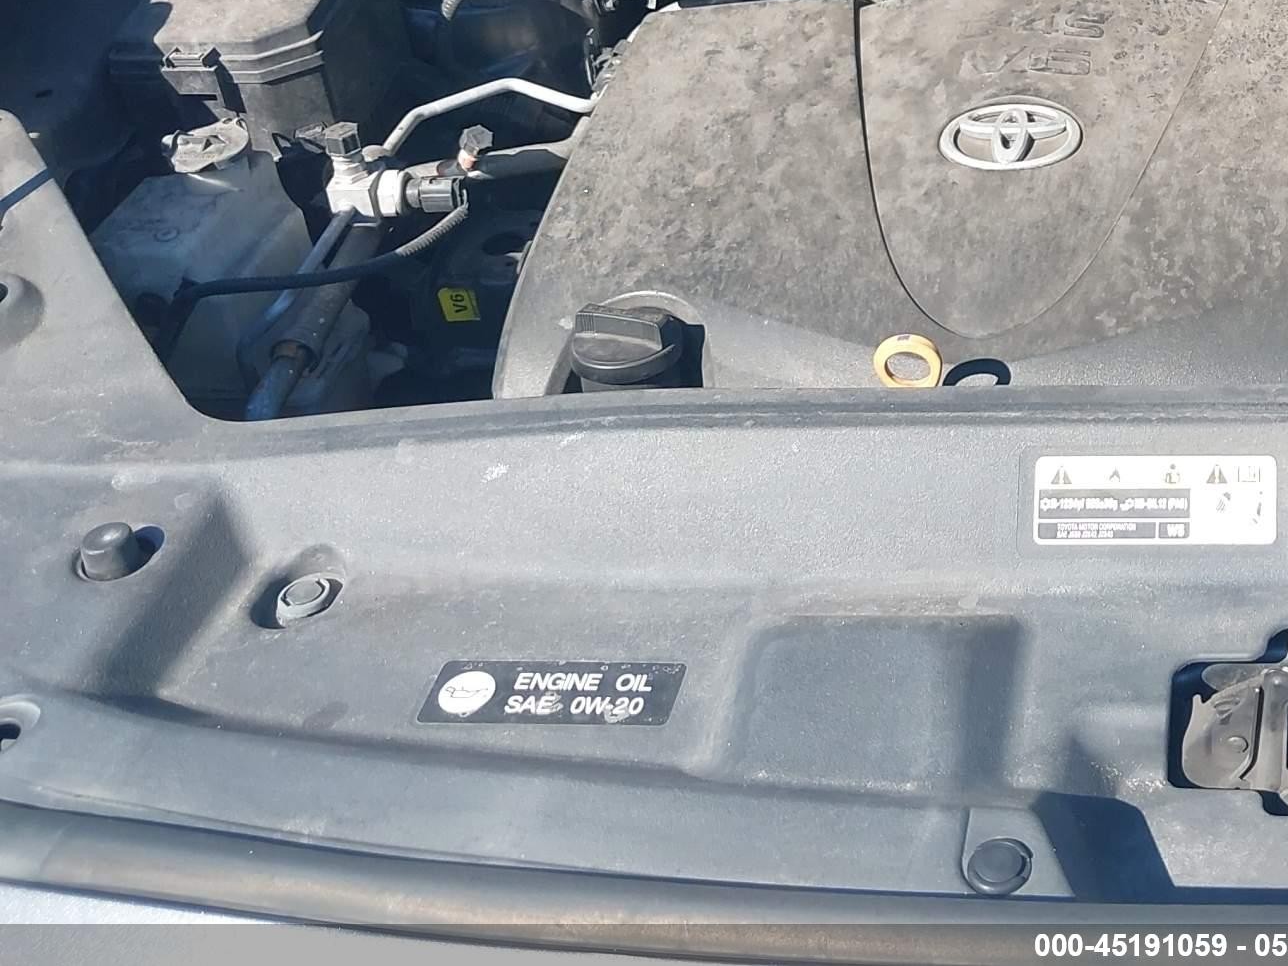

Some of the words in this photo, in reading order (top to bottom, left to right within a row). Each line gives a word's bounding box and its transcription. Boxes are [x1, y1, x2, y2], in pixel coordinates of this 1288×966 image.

[450, 293, 468, 313] V6
[513, 672, 602, 691] ENGINE
[615, 673, 652, 692] OIL
[504, 695, 553, 714] SAE
[570, 696, 644, 715] 0W-20
